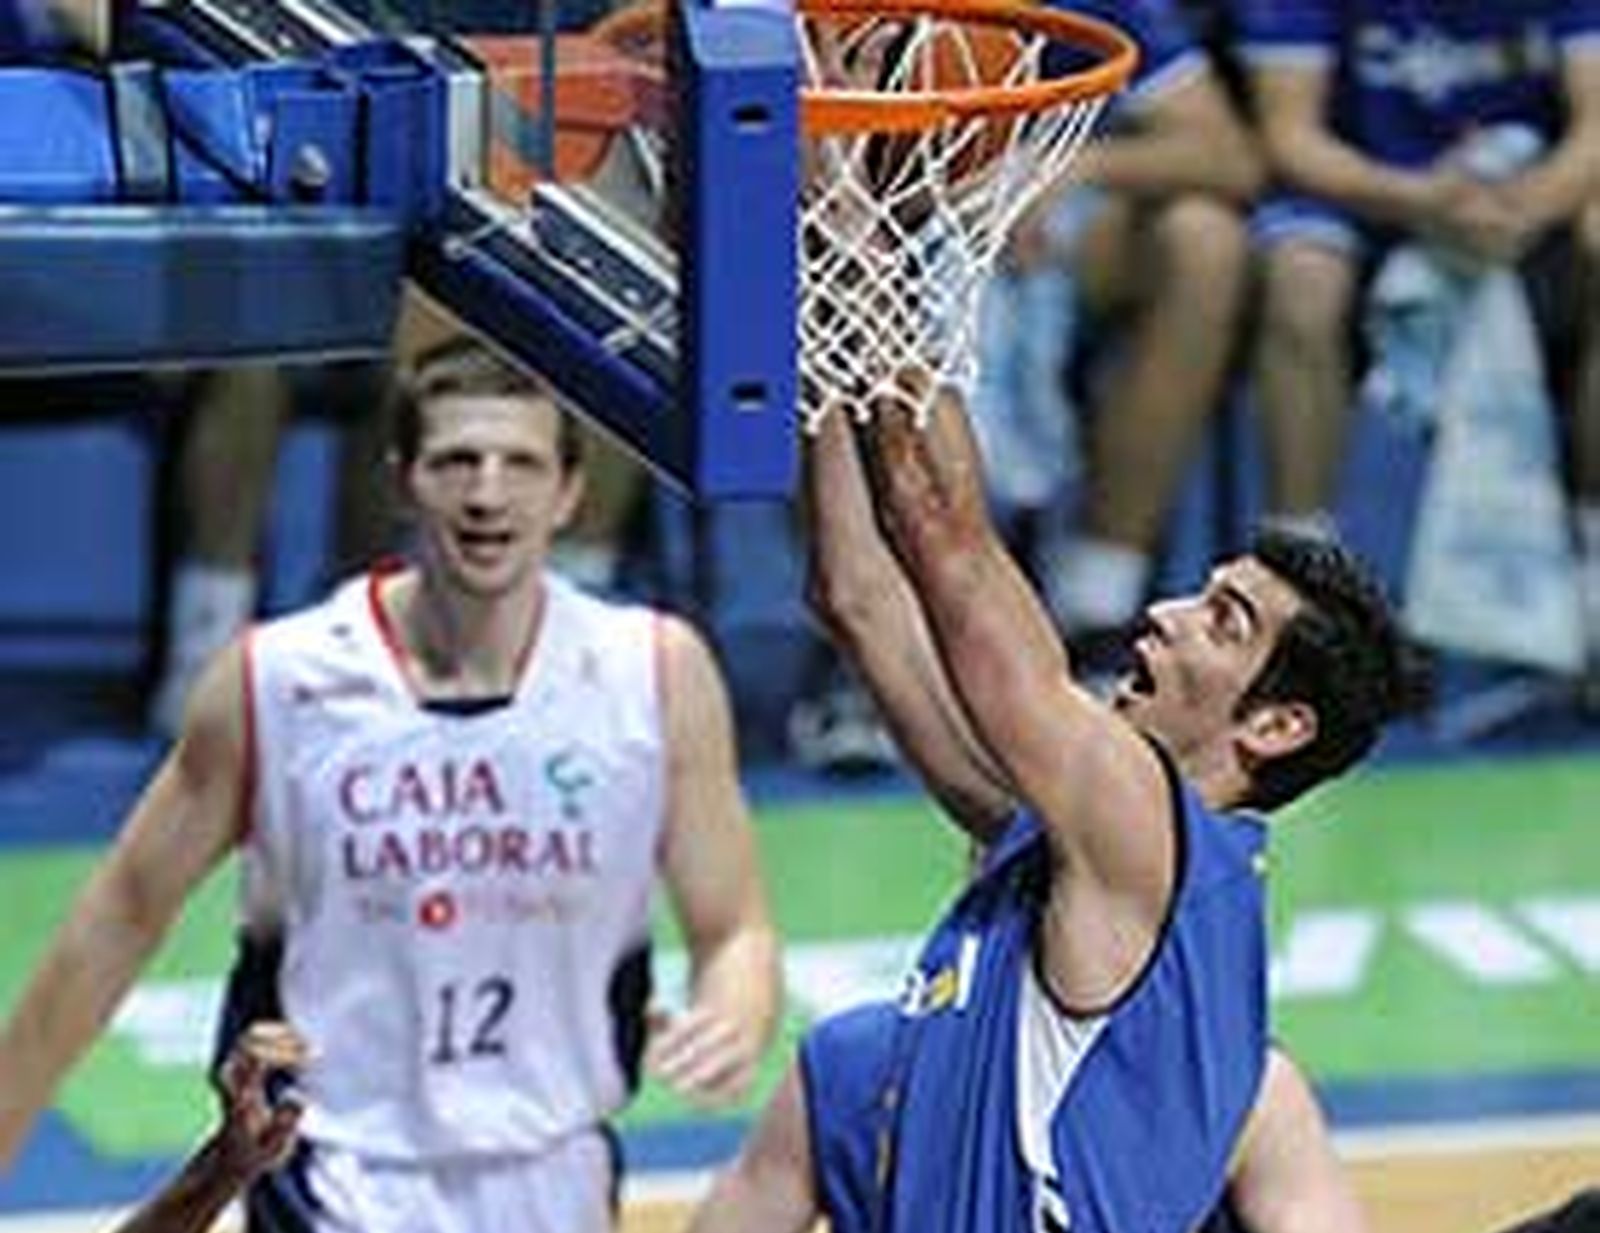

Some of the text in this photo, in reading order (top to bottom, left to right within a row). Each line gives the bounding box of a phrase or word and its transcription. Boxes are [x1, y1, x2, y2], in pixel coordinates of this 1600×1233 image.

[338, 757, 504, 824] CAJA
[343, 825, 598, 880] LABORAL
[430, 975, 516, 1066] 12
